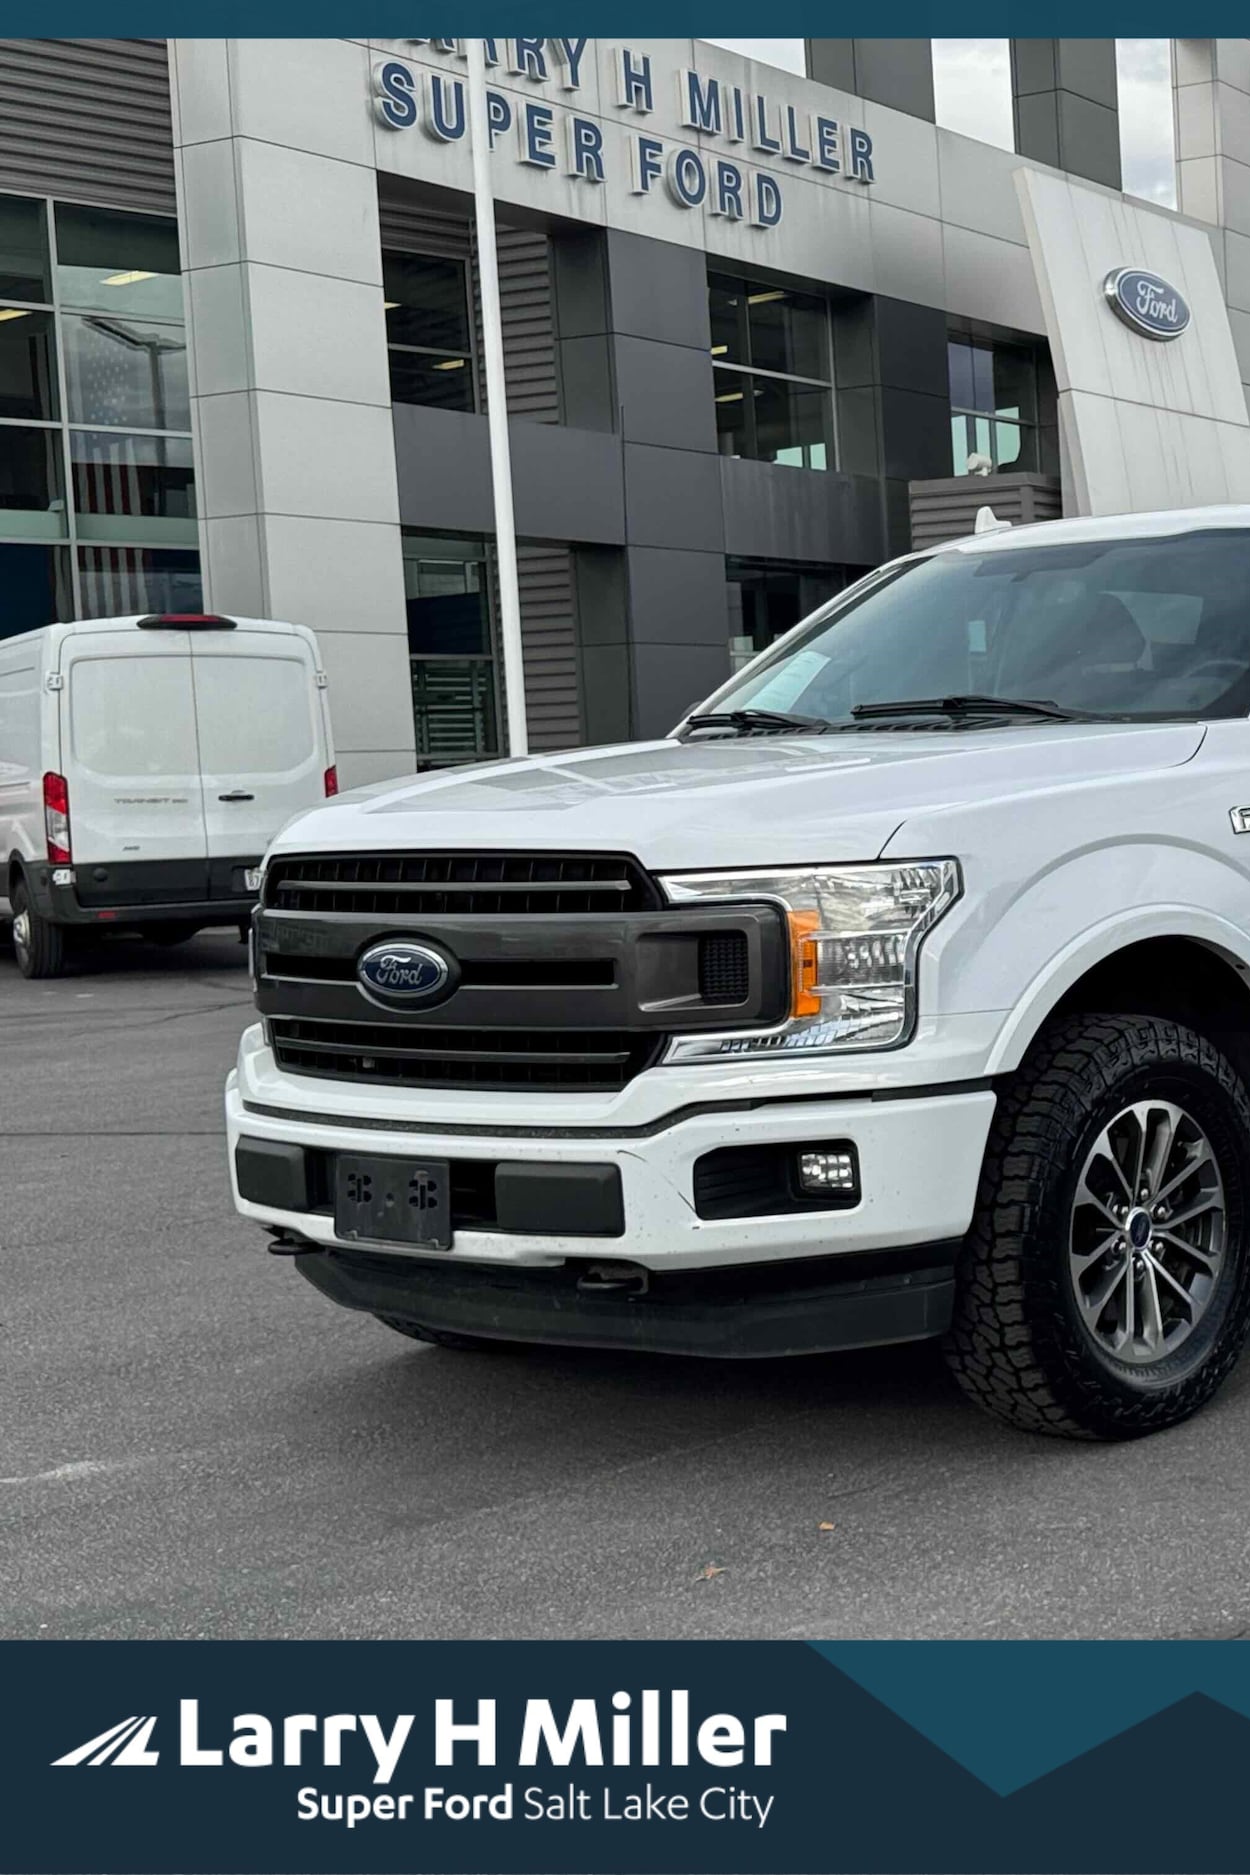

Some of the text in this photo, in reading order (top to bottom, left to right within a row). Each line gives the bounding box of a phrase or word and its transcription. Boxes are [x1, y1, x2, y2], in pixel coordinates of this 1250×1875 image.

[375, 60, 607, 182] SUPER
[632, 134, 783, 228] FORD
[619, 48, 654, 113] H
[680, 67, 875, 183] MILLER
[1135, 280, 1178, 324] Ford
[375, 954, 424, 985] Ford
